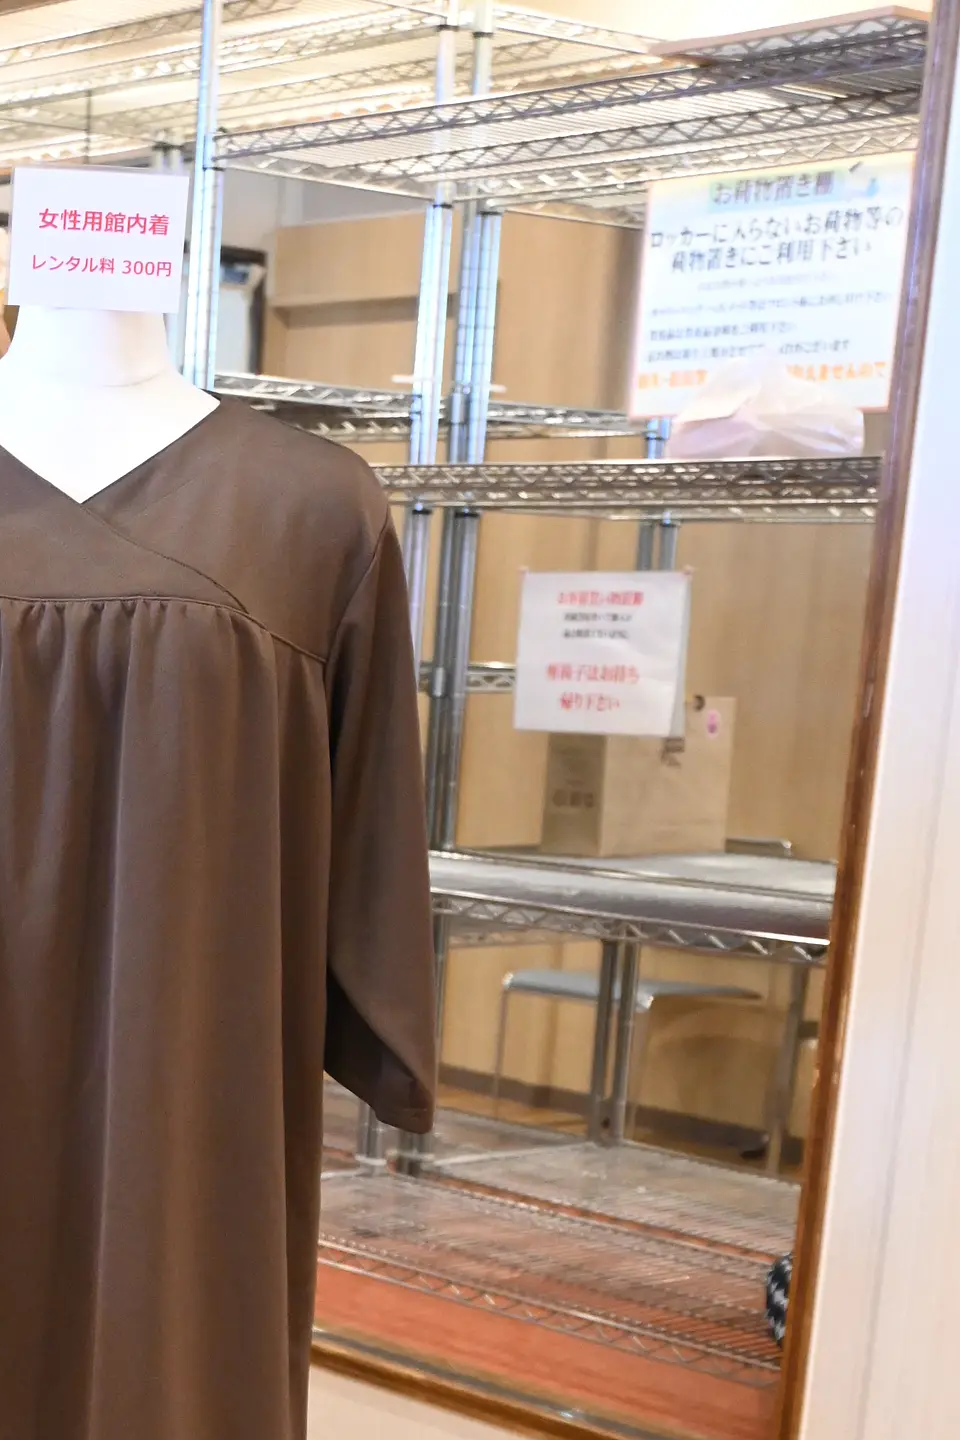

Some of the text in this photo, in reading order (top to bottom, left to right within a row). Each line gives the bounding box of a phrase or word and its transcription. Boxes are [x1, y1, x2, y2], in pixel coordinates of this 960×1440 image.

[38, 208, 170, 236] 女性用館内着
[32, 254, 172, 277] レンタル料 300円
